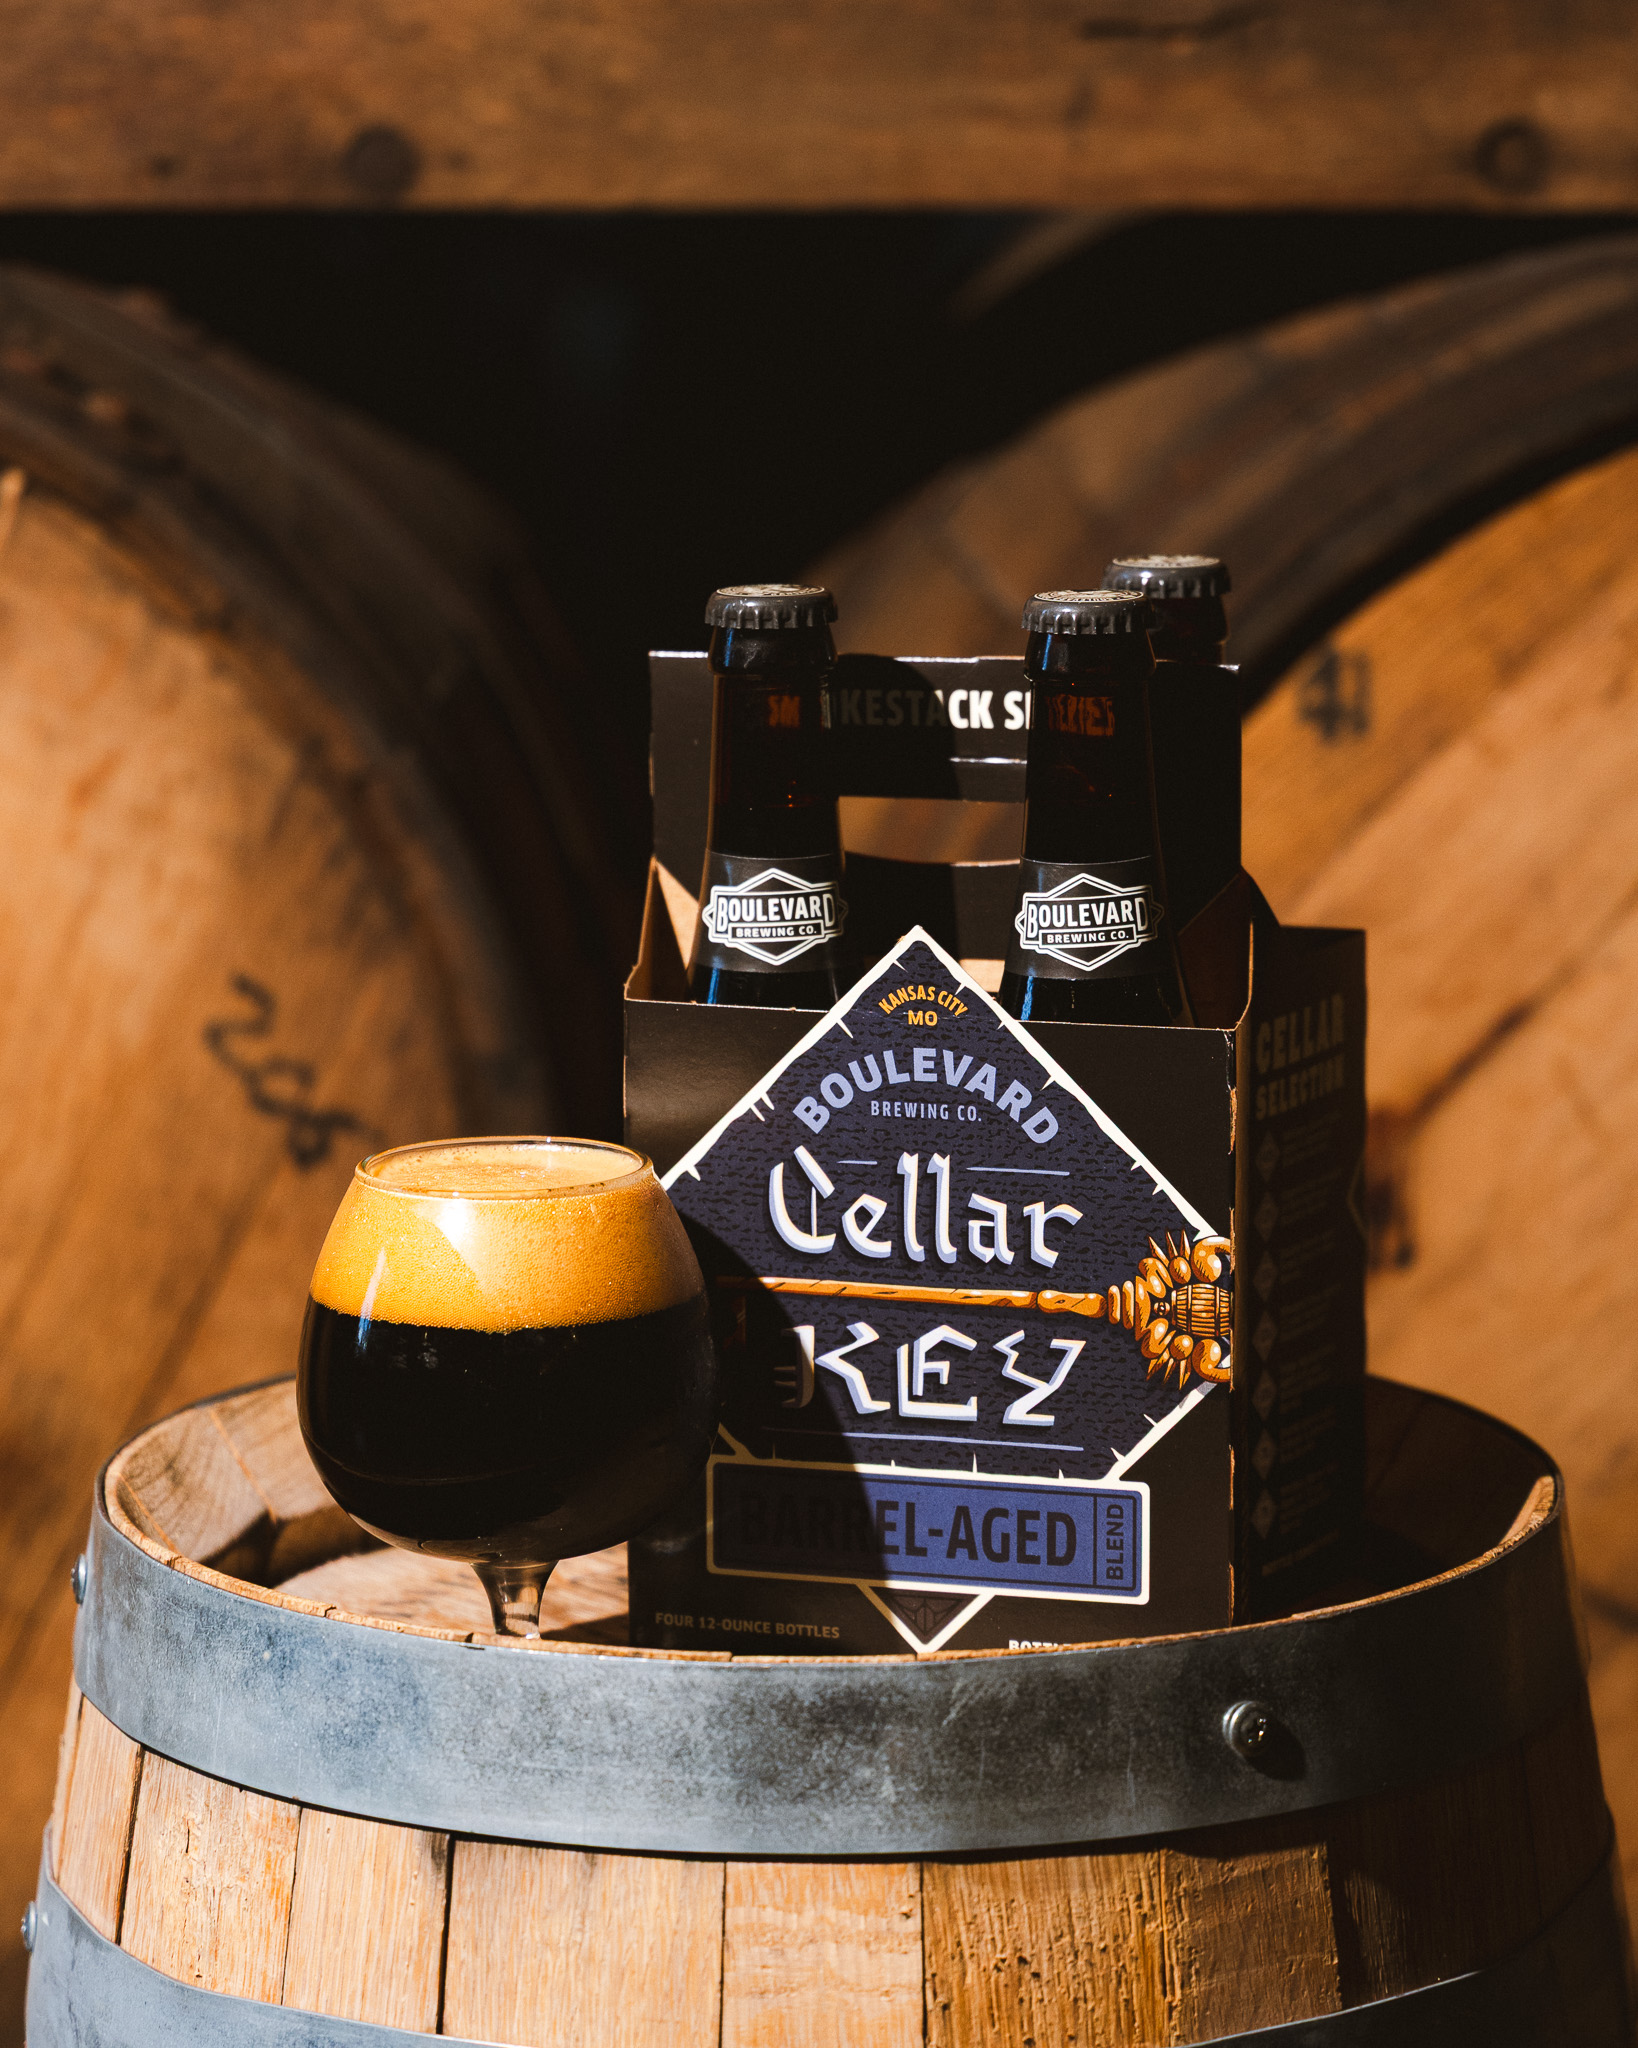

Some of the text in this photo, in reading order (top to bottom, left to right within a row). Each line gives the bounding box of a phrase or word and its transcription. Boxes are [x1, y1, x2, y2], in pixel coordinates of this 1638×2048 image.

[716, 893, 836, 932] BOULEVARD
[735, 925, 817, 938] BREWING CO.
[1027, 897, 1149, 938] BOULEVARD
[1046, 930, 1129, 944] BREWING CO.
[878, 984, 969, 1018] KANSAS CITY
[907, 1009, 938, 1027] MO
[1254, 992, 1346, 1075] CELLAR
[792, 1047, 1059, 1144] BOULEVARD
[870, 1100, 982, 1122] BREWING CO.
[768, 1144, 1084, 1268] Cellar
[774, 1320, 1087, 1427] KEY
[740, 1489, 1077, 1567] BARREL-AGED
[1106, 1504, 1124, 1580] BLEND
[655, 1612, 840, 1639] FOUR 12-OUNCE BOTTLES
